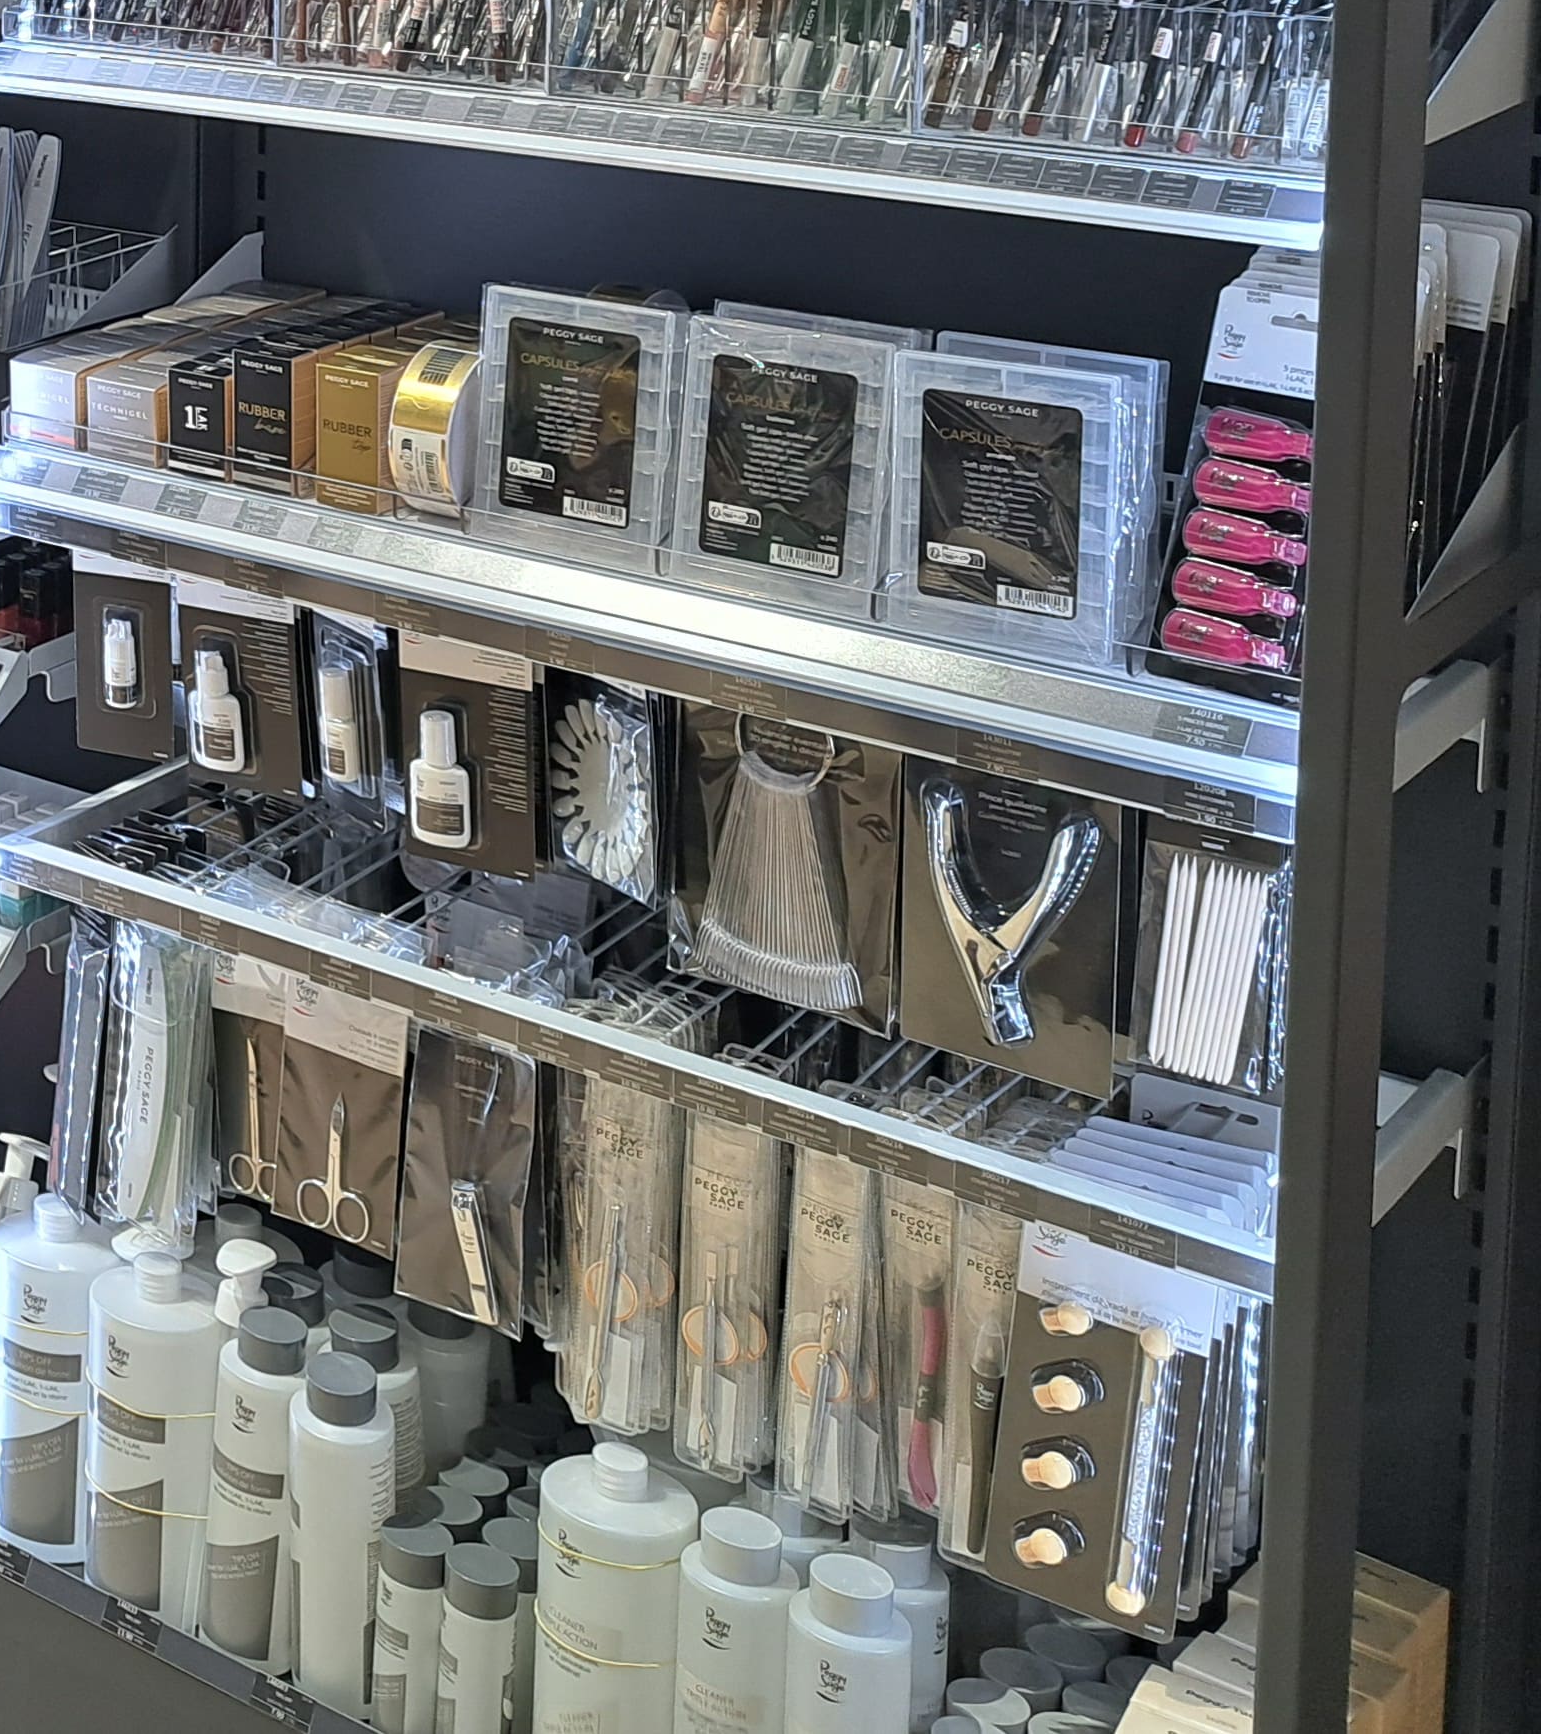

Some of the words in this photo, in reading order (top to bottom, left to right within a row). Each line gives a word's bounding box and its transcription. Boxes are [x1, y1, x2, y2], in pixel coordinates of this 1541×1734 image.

[542, 326, 576, 339] PEGGY
[578, 332, 605, 345] SAGE
[241, 358, 262, 370] PEGGY
[520, 352, 580, 372] CAPSULES
[324, 373, 346, 385] PEGGY
[347, 378, 370, 388] SAGE
[751, 365, 786, 380] PEGGY
[789, 370, 818, 384] SAGE
[97, 384, 119, 395] PEGGY
[121, 389, 142, 398] SAGE
[91, 401, 148, 420] TECHNIGEL
[238, 401, 286, 422] RUBBER
[725, 392, 790, 413] CAPSULES
[965, 399, 1005, 414] PEGGY
[1007, 404, 1039, 418] SAGE
[322, 418, 373, 438] RUBBER
[939, 427, 1012, 447] CAPSULES
[144, 1046, 156, 1089] PEGGY
[139, 1090, 153, 1126] SAGE
[596, 1126, 638, 1146] PEGGY
[610, 1142, 644, 1160] SAGE
[694, 1176, 739, 1198] PEGGY
[709, 1192, 745, 1210] SAGE
[801, 1207, 844, 1231] PEGGY
[890, 1208, 935, 1232] PEGGY
[815, 1224, 850, 1244] SAGE
[905, 1225, 942, 1246] SAGE
[1035, 1225, 1067, 1245] Sage
[967, 1258, 1015, 1280] PEGGY
[22, 1283, 49, 1308] Peggy
[22, 1297, 46, 1315] Sage
[107, 1334, 130, 1358] Peggy
[107, 1348, 129, 1368] Sage
[235, 1394, 257, 1416] Peggy
[235, 1408, 255, 1424] Sage
